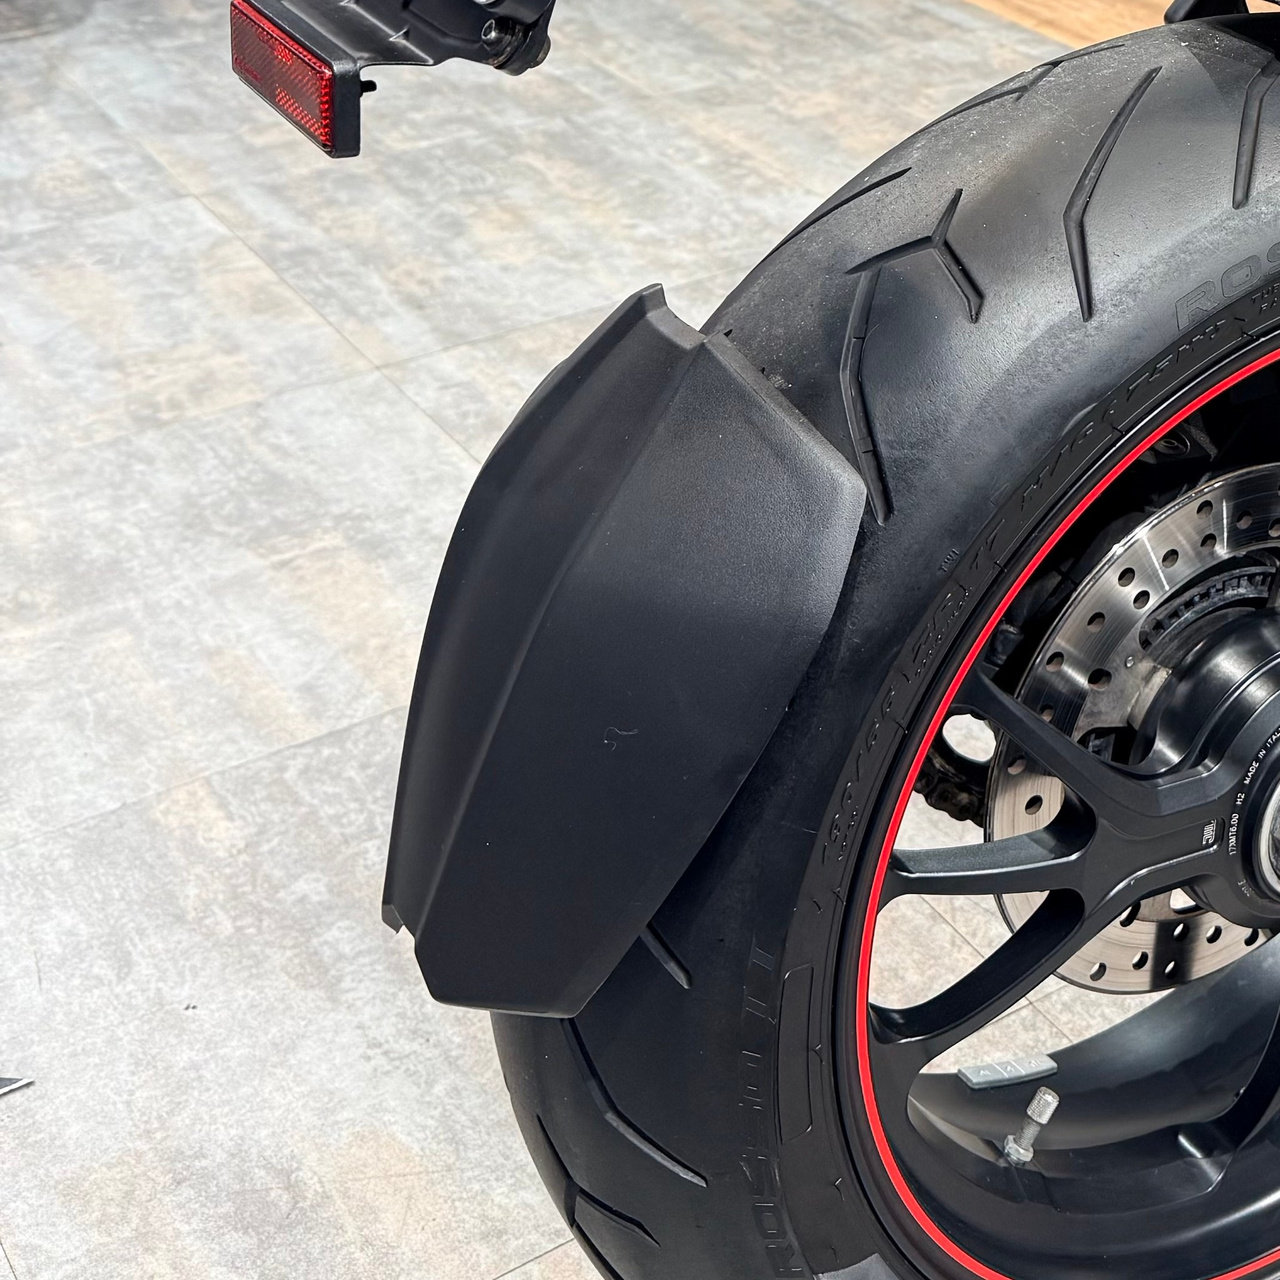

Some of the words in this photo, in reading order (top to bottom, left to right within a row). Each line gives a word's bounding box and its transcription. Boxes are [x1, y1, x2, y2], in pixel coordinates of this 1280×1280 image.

[1235, 791, 1247, 807] H2
[1242, 761, 1260, 786] MADE
[1257, 748, 1267, 761] IN
